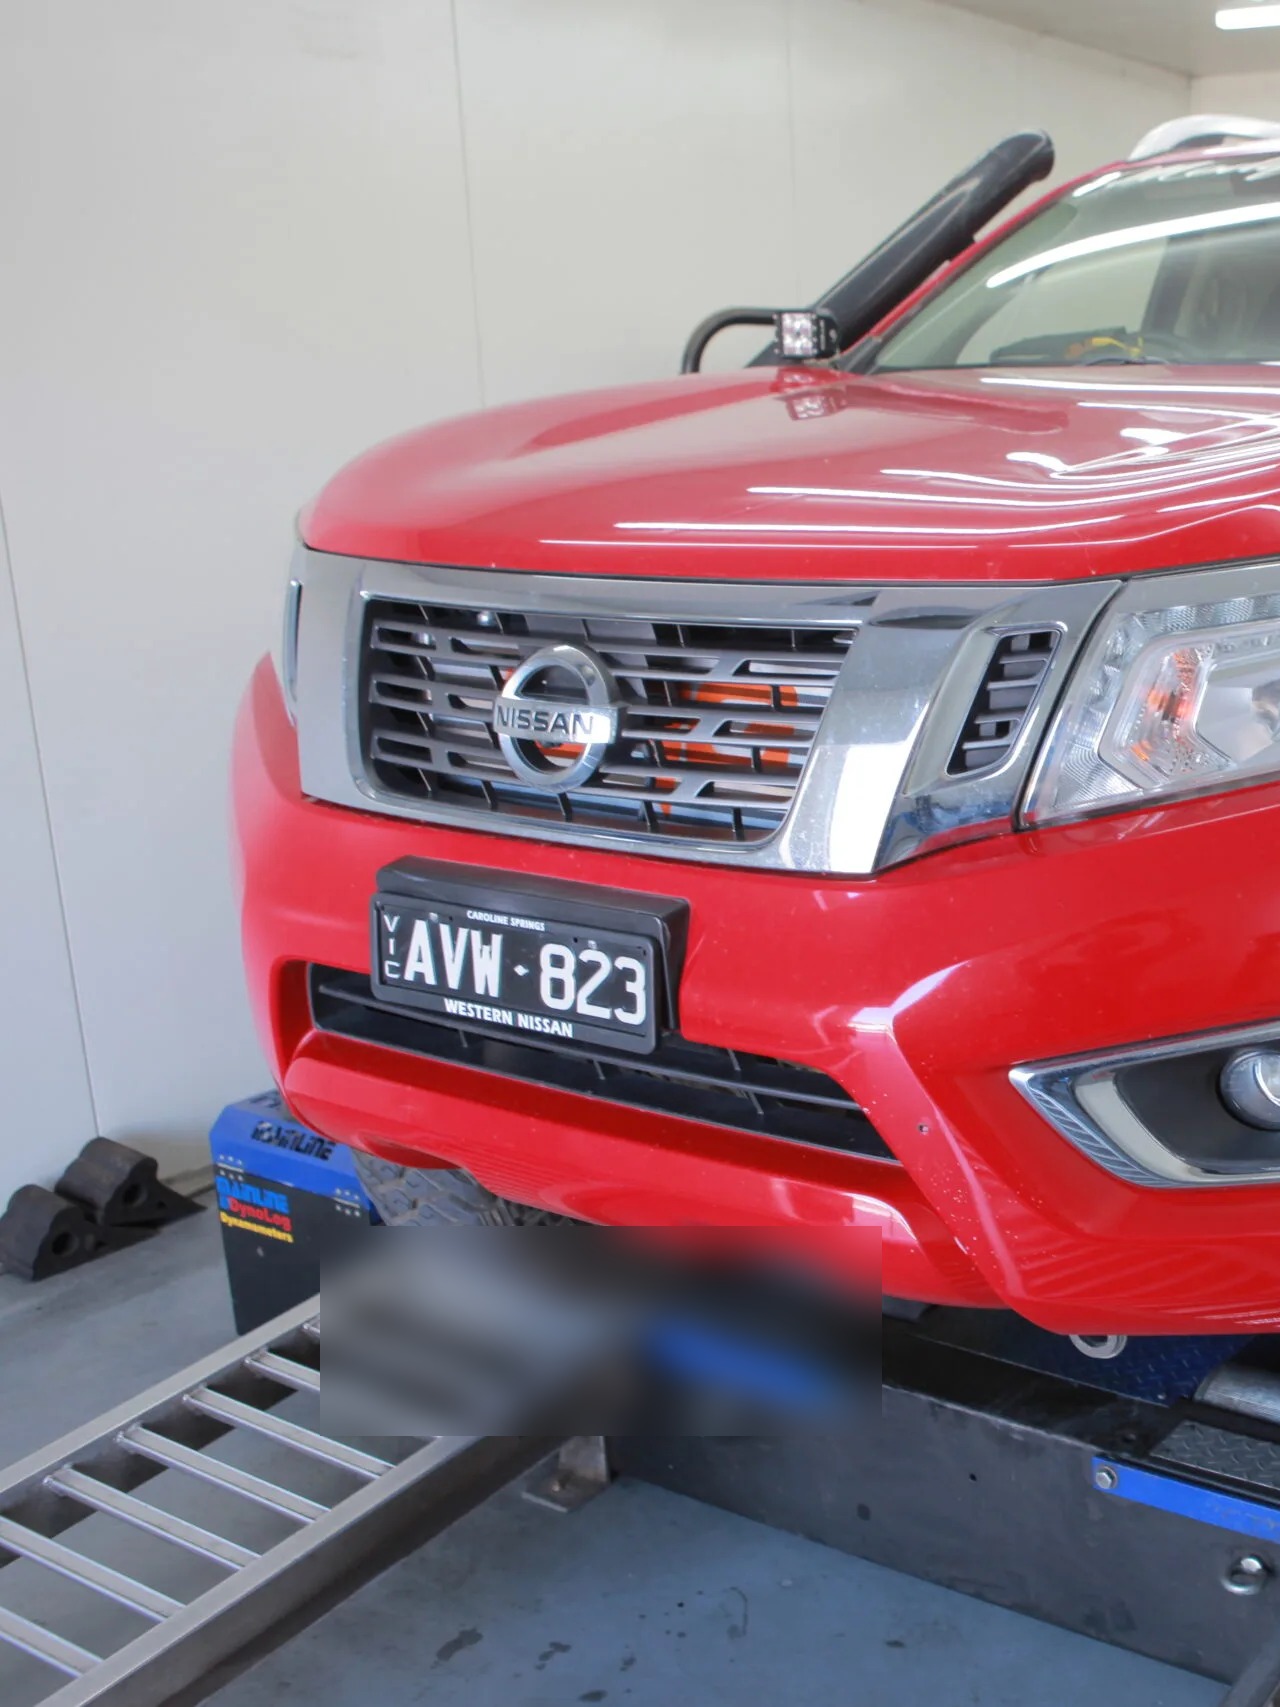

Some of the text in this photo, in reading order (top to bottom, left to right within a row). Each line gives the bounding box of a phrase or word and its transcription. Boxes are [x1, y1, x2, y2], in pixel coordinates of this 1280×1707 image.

[496, 705, 593, 735] NISSAN
[466, 910, 546, 932] CAROLINE SPRINGS
[384, 915, 401, 979] VIC
[403, 919, 647, 1026] AVW 823
[444, 998, 573, 1038] WESTERN NISSAN
